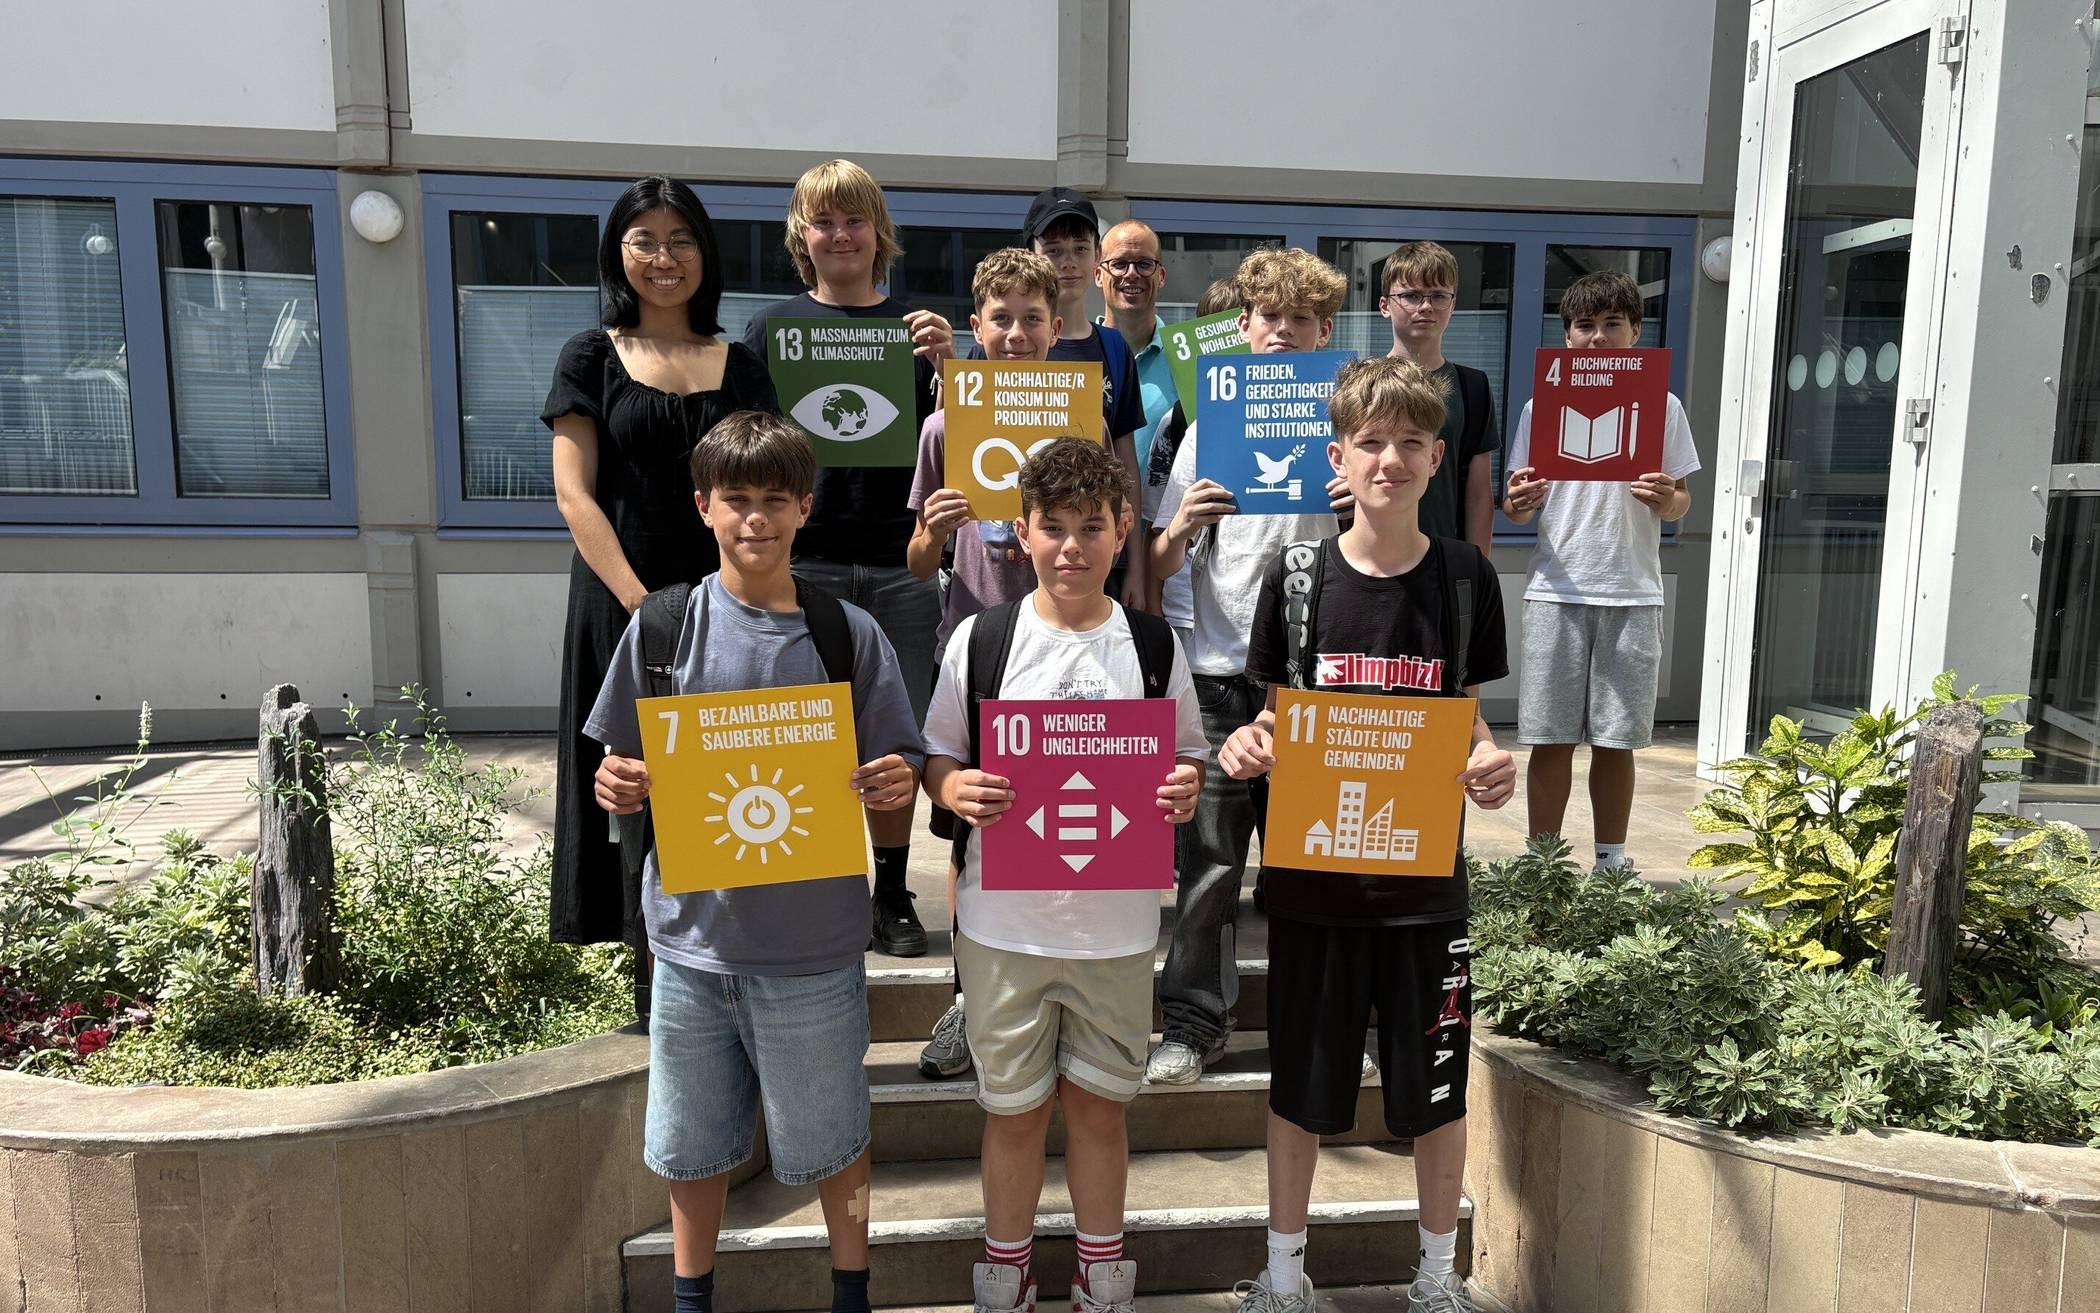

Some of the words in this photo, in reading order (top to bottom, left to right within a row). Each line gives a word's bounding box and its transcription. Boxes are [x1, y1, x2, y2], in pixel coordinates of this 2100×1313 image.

[811, 328, 886, 343] MASSNAHMEN
[887, 327, 909, 343] ZUM
[1195, 317, 1239, 340] GESUNDH
[775, 327, 803, 361] 13
[811, 345, 884, 361] KLIMASCHUTZ
[1172, 332, 1192, 361] 3
[1245, 364, 1297, 380] FRIEDEN,
[1545, 357, 1562, 387] 4
[1571, 357, 1643, 371] HOCHWERTIGE
[954, 371, 984, 406] 12
[994, 372, 1085, 389] NACHHALTIGE/R
[1207, 365, 1237, 401] 16
[1571, 373, 1613, 387] BILDUNG
[994, 392, 1043, 408] KONSUM
[1045, 392, 1069, 408] UND
[1245, 382, 1335, 400] GERECHTIGKEIT
[994, 411, 1069, 427] PRODUKTION
[1246, 404, 1271, 419] UND
[1272, 403, 1316, 418] STARKE
[1245, 421, 1332, 438] INSTITUTIONEN
[1346, 653, 1443, 691] limpbizk
[1084, 680, 1102, 688] TRY
[699, 701, 798, 727] BEZAHLBARE
[801, 699, 833, 718] UND
[1042, 714, 1106, 732] WENIGER
[1287, 703, 1317, 744] 11
[1328, 705, 1427, 728] NACHHALTIGE
[658, 711, 679, 754] 7
[702, 728, 772, 751] SAUBERE
[775, 722, 837, 745] ENERGIE
[992, 713, 1031, 756] 10
[1326, 726, 1380, 749] STÄDTE
[1382, 731, 1412, 749] UND
[1042, 736, 1158, 756] UNGLEICHHEITEN
[1324, 750, 1405, 771] GEMEINDEN
